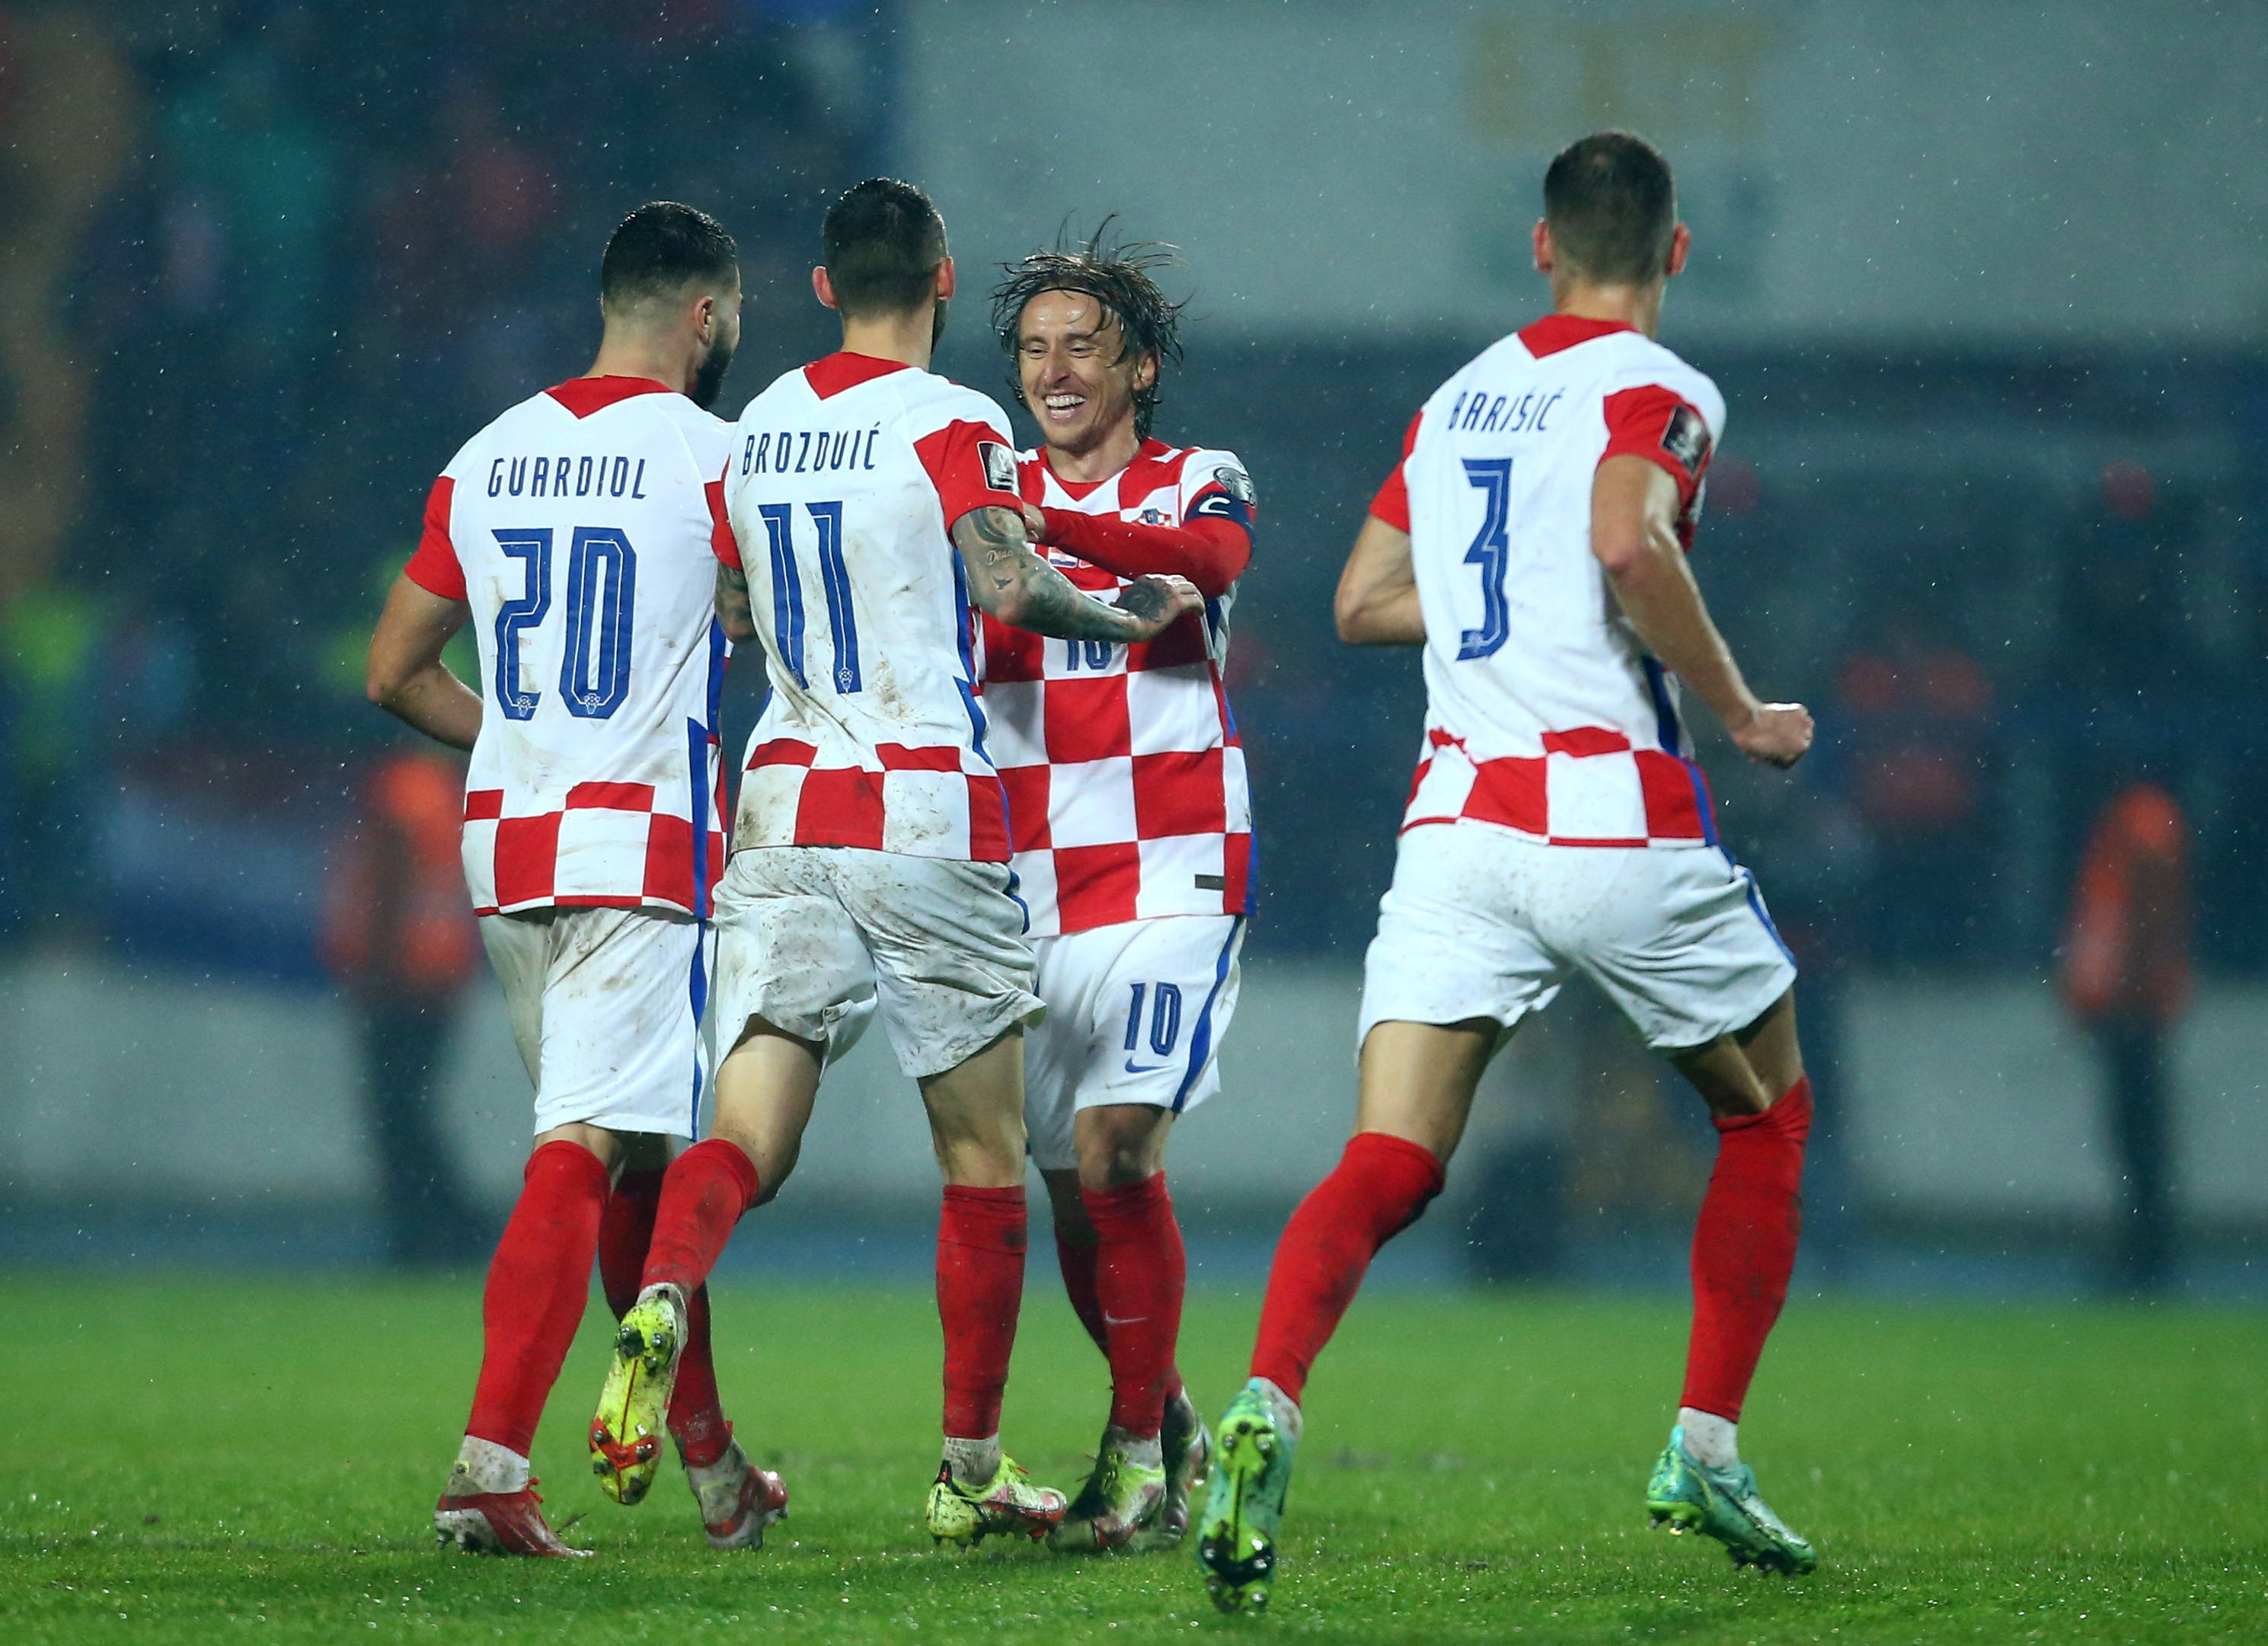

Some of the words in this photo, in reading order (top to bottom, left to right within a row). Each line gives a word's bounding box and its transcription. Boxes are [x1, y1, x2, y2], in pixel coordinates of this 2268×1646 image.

[487, 455, 647, 500] GUARDIOL
[1455, 457, 1513, 661] 3
[490, 526, 637, 721] 20
[758, 500, 862, 694] 11
[1123, 981, 1182, 1057] 10
